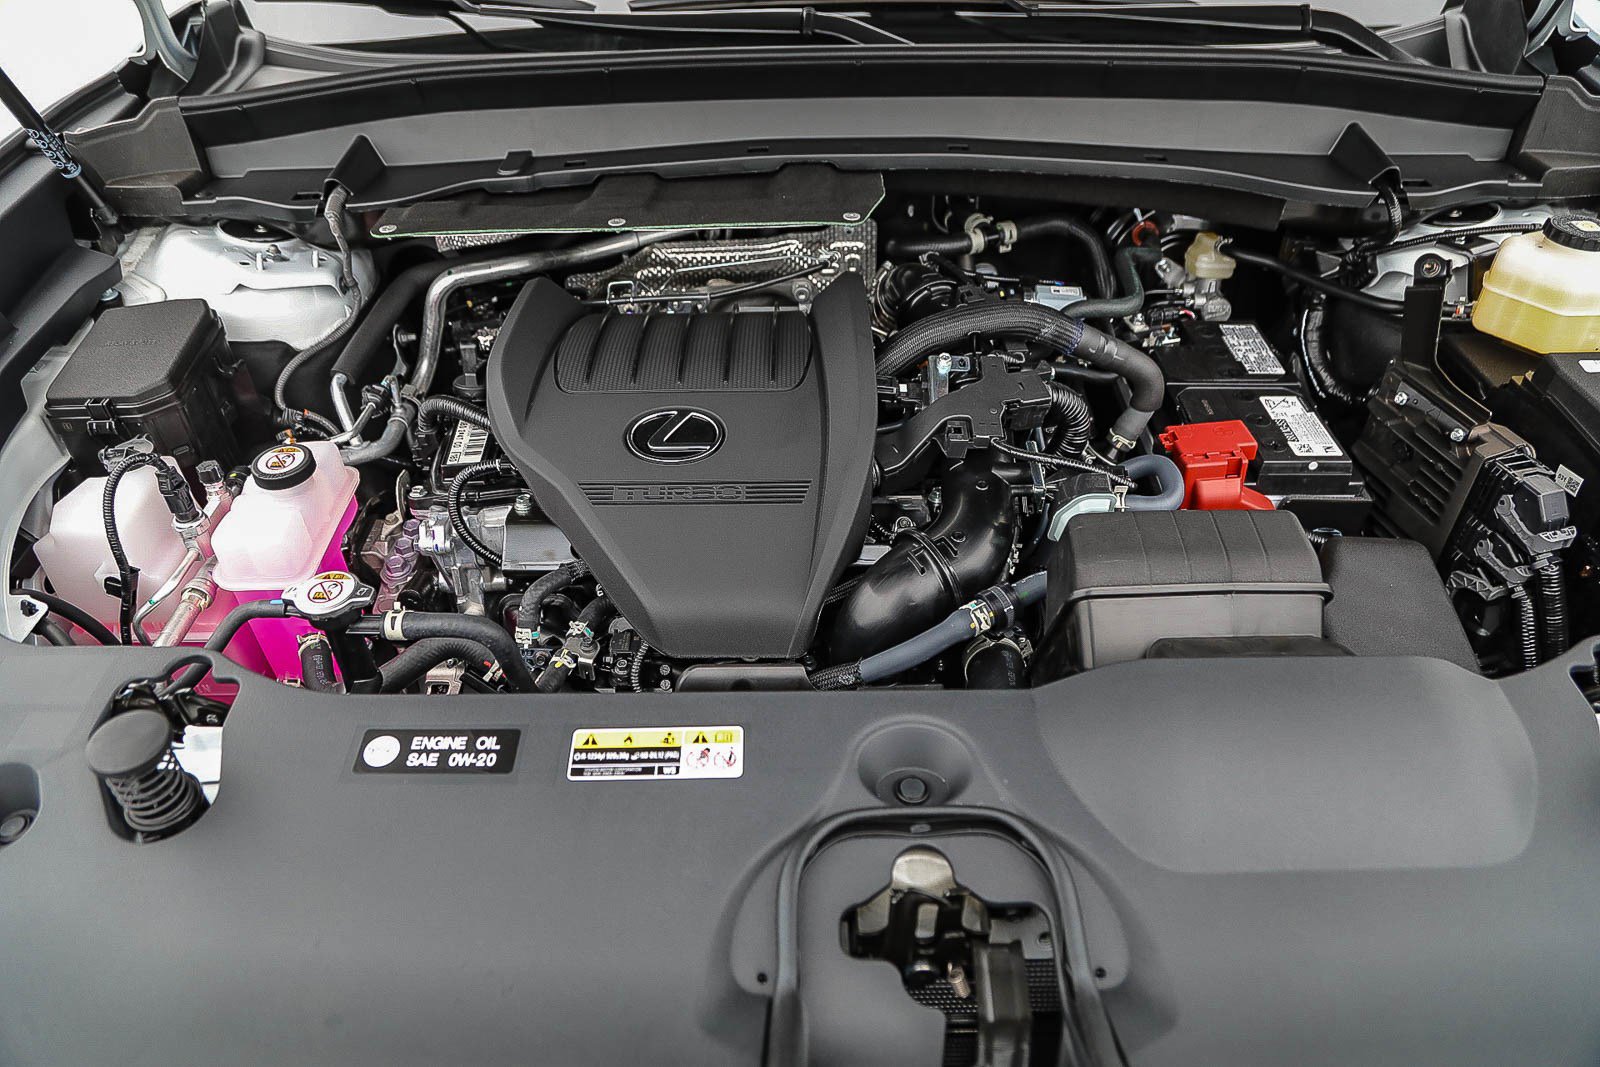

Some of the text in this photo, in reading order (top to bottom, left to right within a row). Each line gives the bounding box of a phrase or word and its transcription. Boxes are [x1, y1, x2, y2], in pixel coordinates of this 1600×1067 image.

[613, 485, 746, 501] TURBO
[410, 736, 501, 750] ENGINE OIL
[406, 752, 497, 767] SAE 0W-20
